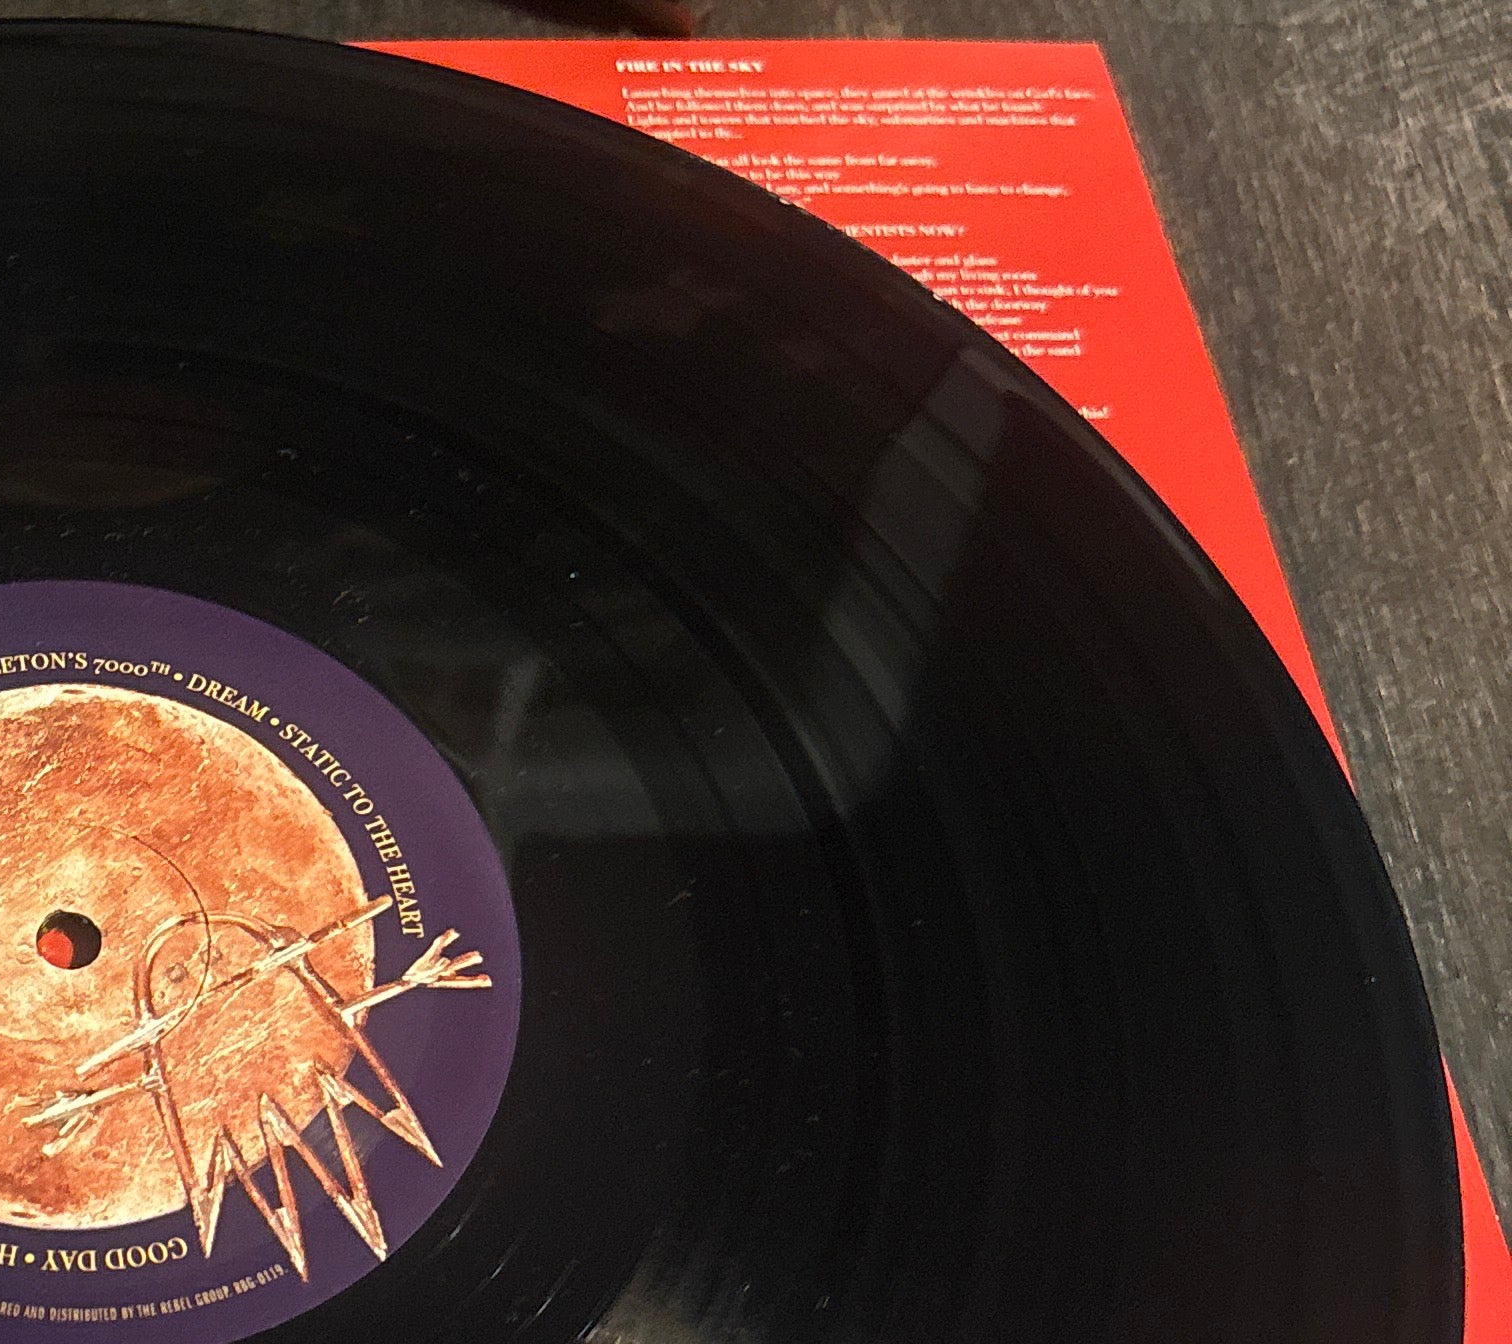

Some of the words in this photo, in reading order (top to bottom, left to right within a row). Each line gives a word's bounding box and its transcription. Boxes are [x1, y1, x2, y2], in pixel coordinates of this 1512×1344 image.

[615, 59, 659, 73] FIRE
[662, 60, 685, 73] IN
[687, 59, 726, 73] THE
[728, 60, 766, 73] SKY
[186, 673, 270, 723] DREAM
[279, 723, 351, 787] STATIC
[343, 783, 374, 816] TO
[365, 815, 403, 862] THE
[387, 863, 424, 939] HEART
[40, 1249, 98, 1272] DAY
[105, 1236, 188, 1270] GOOD
[23, 1305, 45, 1321] AND
[49, 1307, 117, 1322] DISTRIBUTED
[121, 1307, 135, 1320] BY
[136, 1302, 157, 1318] THE
[159, 1296, 192, 1315] REBEL
